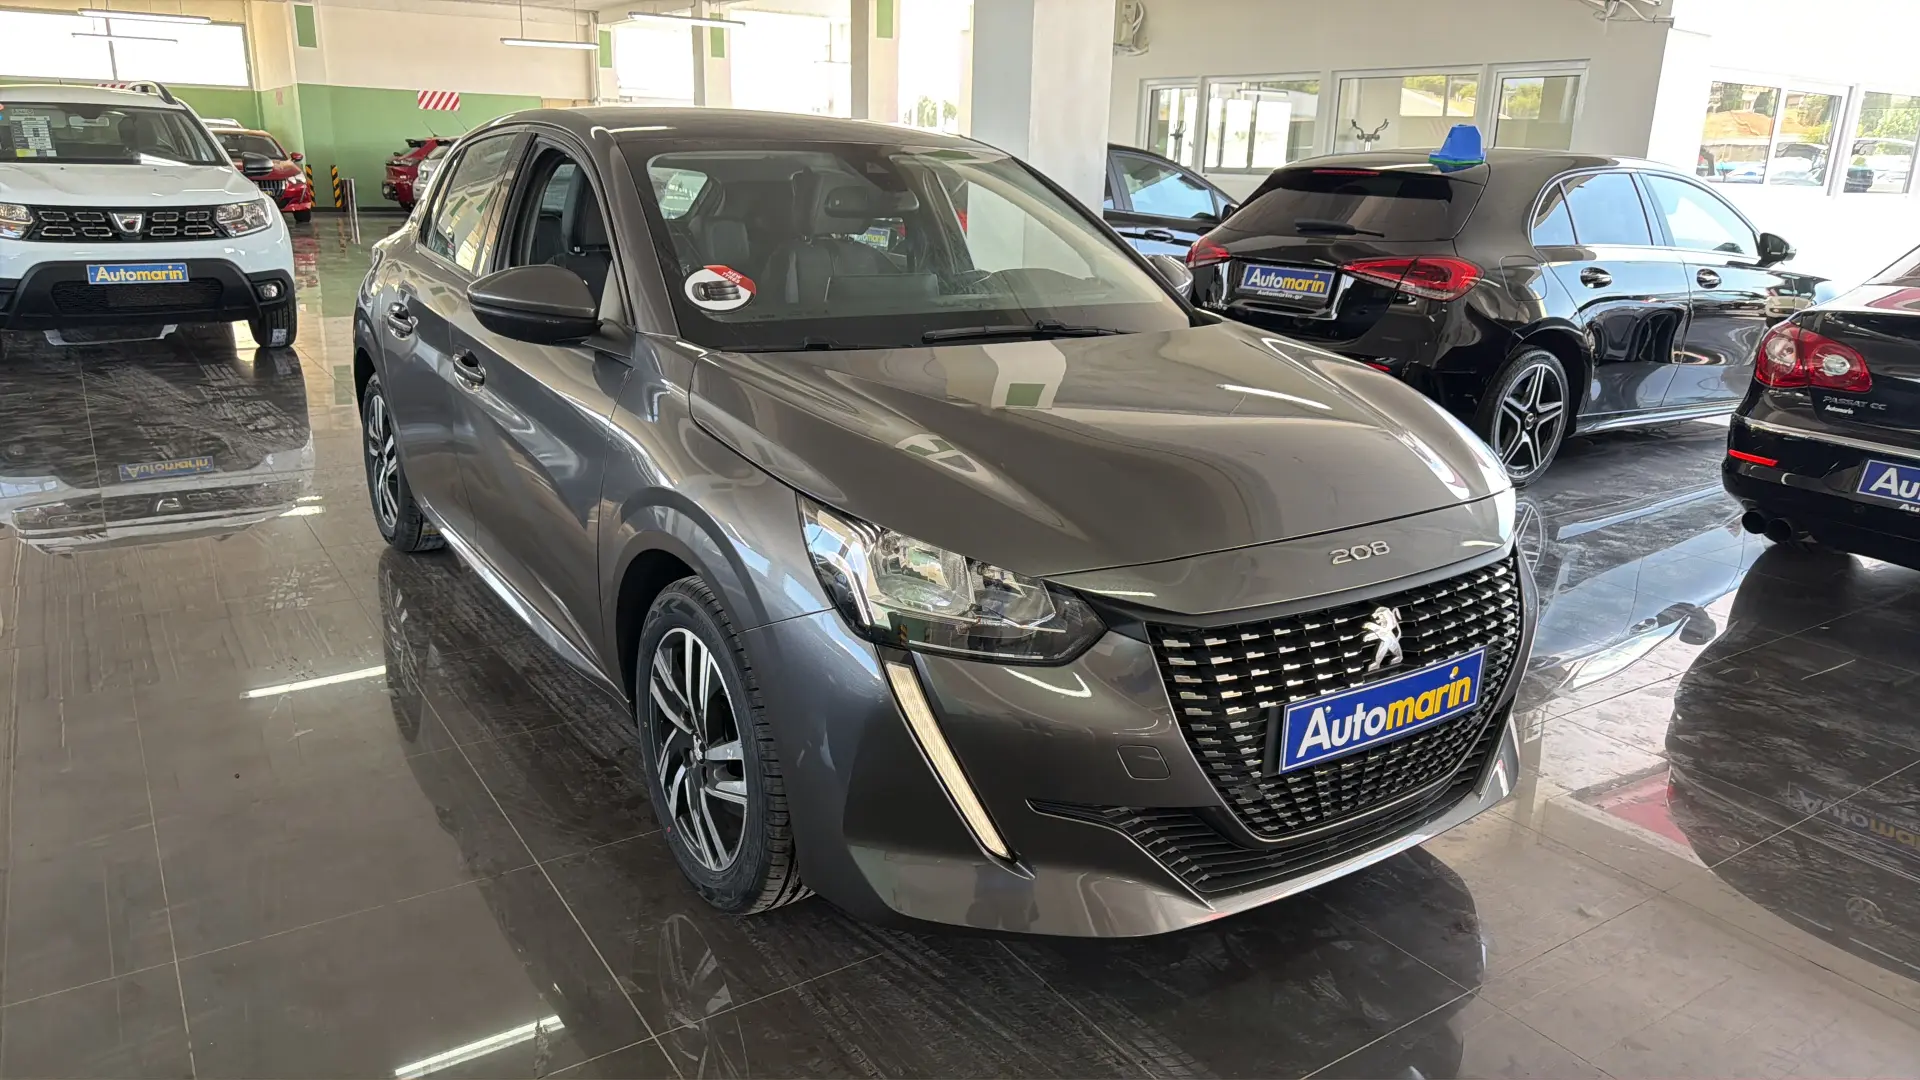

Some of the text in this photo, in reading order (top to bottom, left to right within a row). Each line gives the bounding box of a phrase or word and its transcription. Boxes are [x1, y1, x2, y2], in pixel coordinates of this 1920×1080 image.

[95, 265, 183, 282] Automarin
[1248, 268, 1325, 293] Automarin
[1256, 290, 1304, 300] Automarin.gr
[1823, 395, 1887, 411] PASSAT CC
[1869, 467, 1920, 500] Au
[1330, 540, 1390, 565] 208
[1296, 665, 1472, 759] Automarin
